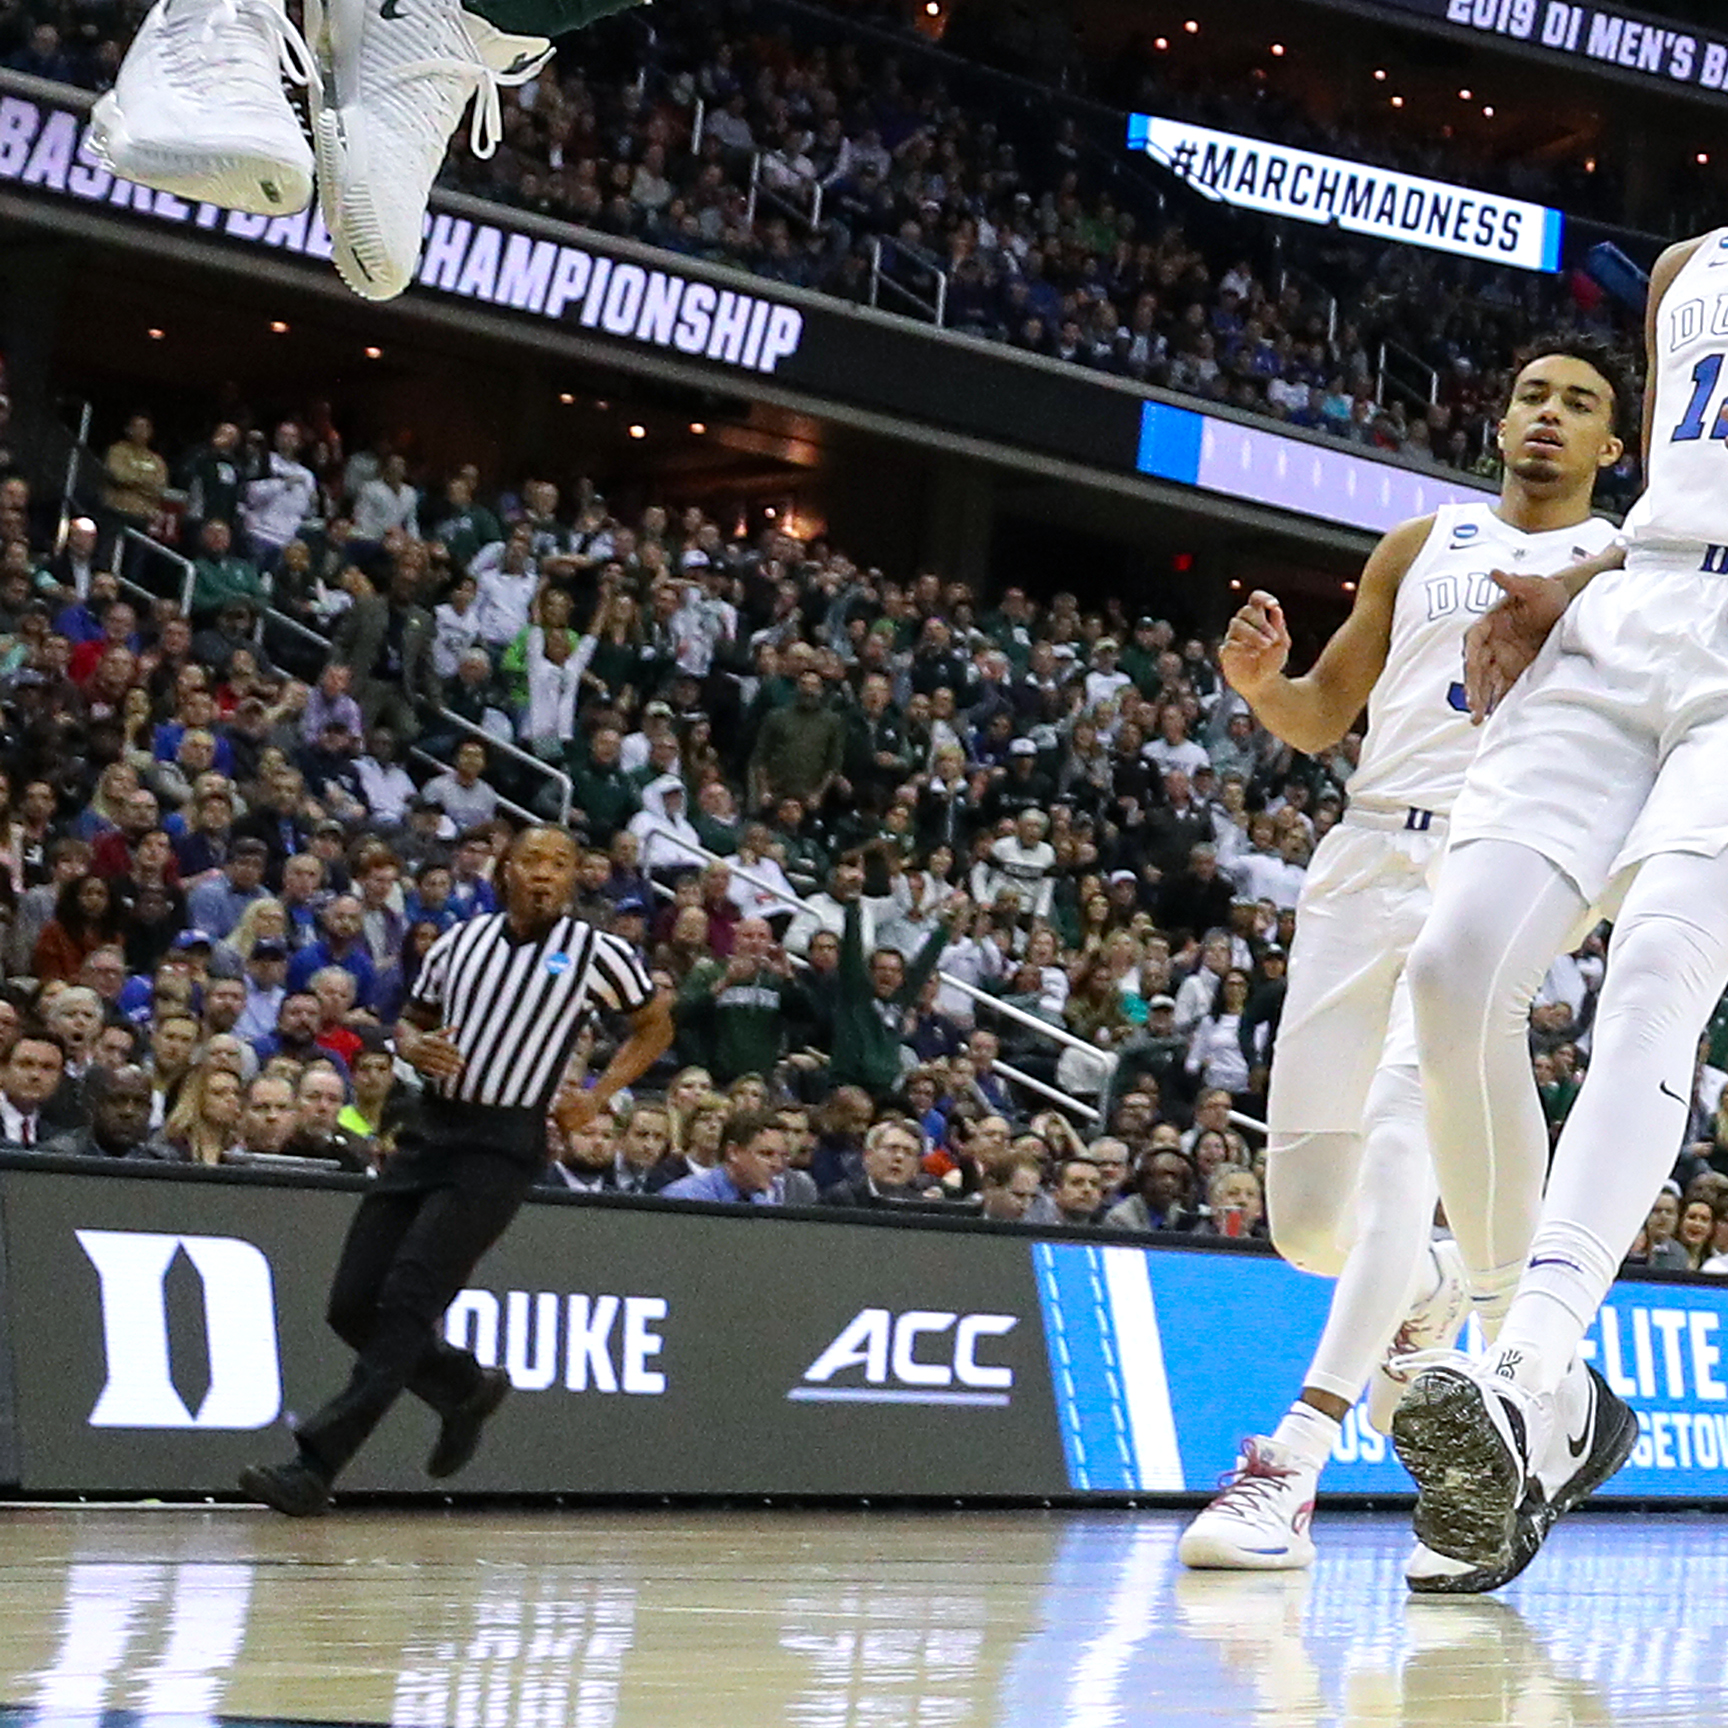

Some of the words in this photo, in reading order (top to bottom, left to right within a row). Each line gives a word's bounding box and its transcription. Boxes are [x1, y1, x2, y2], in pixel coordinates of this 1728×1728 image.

[1541, 0, 1584, 52] DI
[1585, 12, 1697, 80] MEN'S
[1172, 139, 1523, 253] #MARCHMADNESS
[420, 212, 803, 373] HAMPIONSHIP
[75, 1229, 285, 1430] D
[444, 1288, 669, 1396] DUKE
[802, 1307, 1020, 1389] ACC
[1577, 1306, 1728, 1401] LITE
